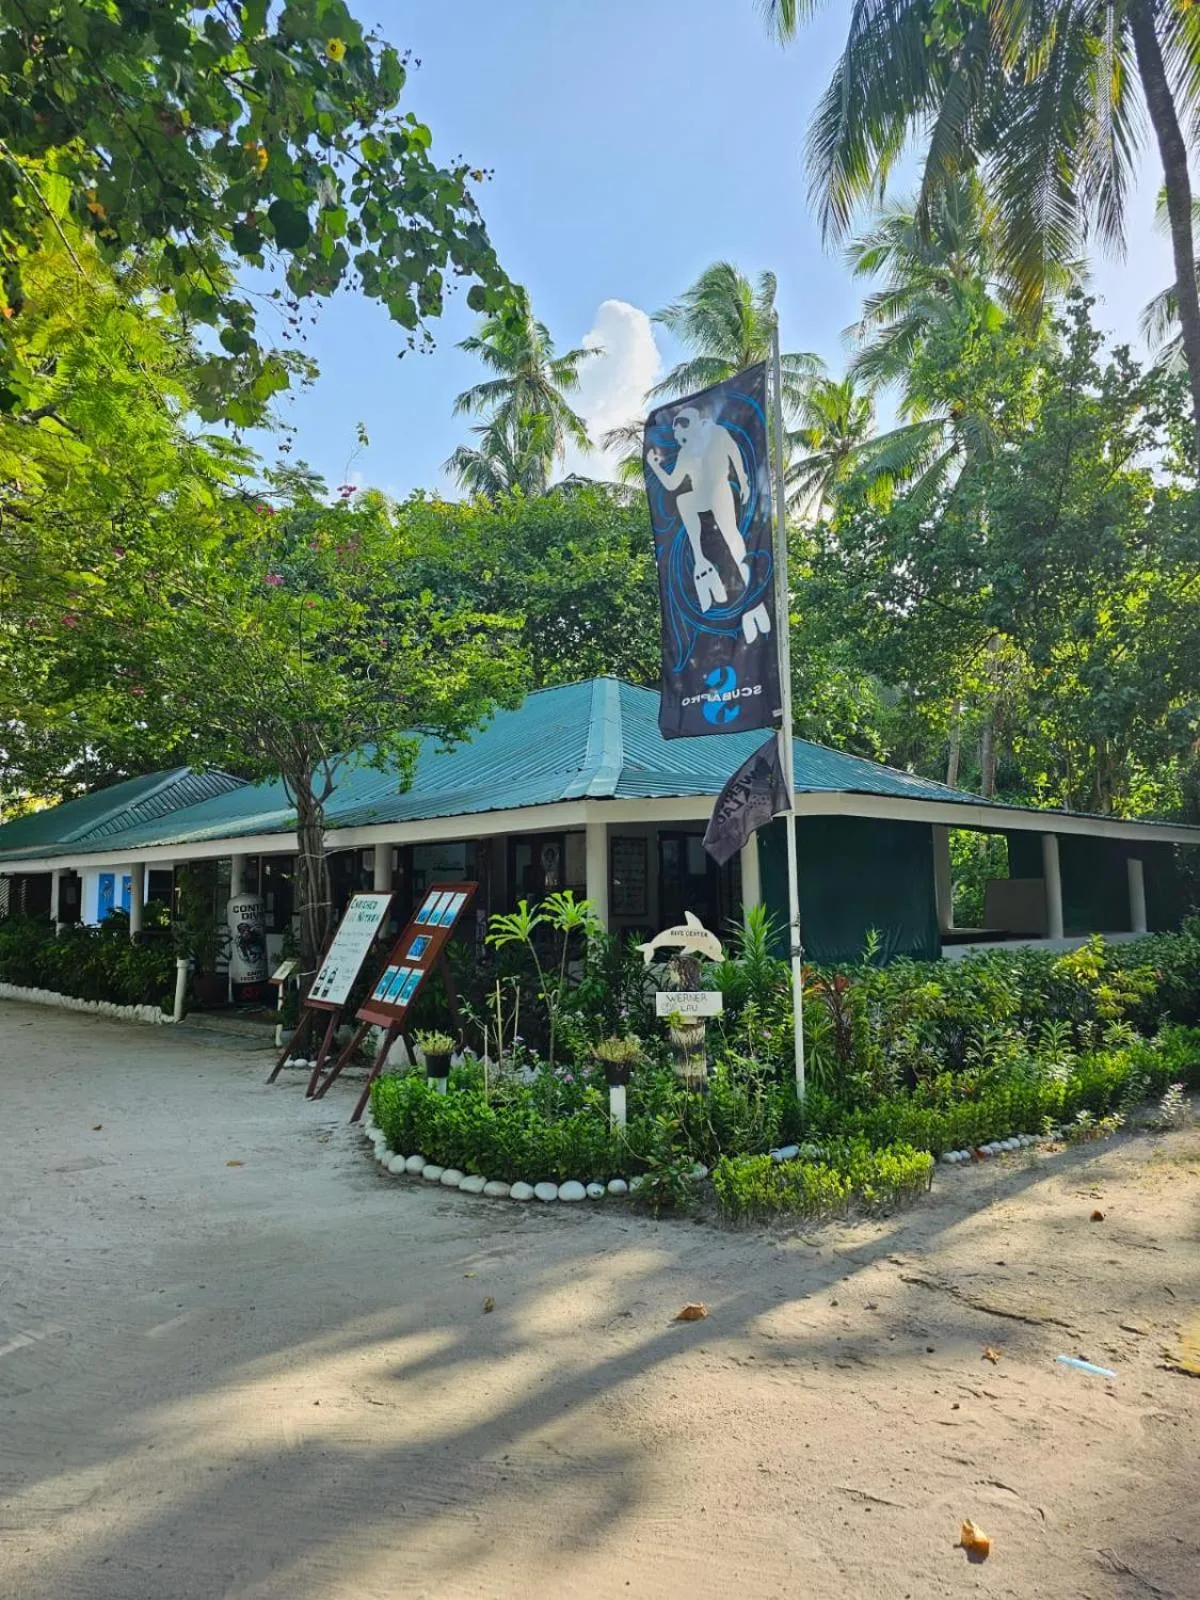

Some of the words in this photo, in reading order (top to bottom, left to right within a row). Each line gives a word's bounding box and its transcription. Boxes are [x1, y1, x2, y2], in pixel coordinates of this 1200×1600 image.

[685, 930, 708, 938] CENTER
[665, 992, 708, 1003] WERNER
[680, 1004, 697, 1013] LAU
